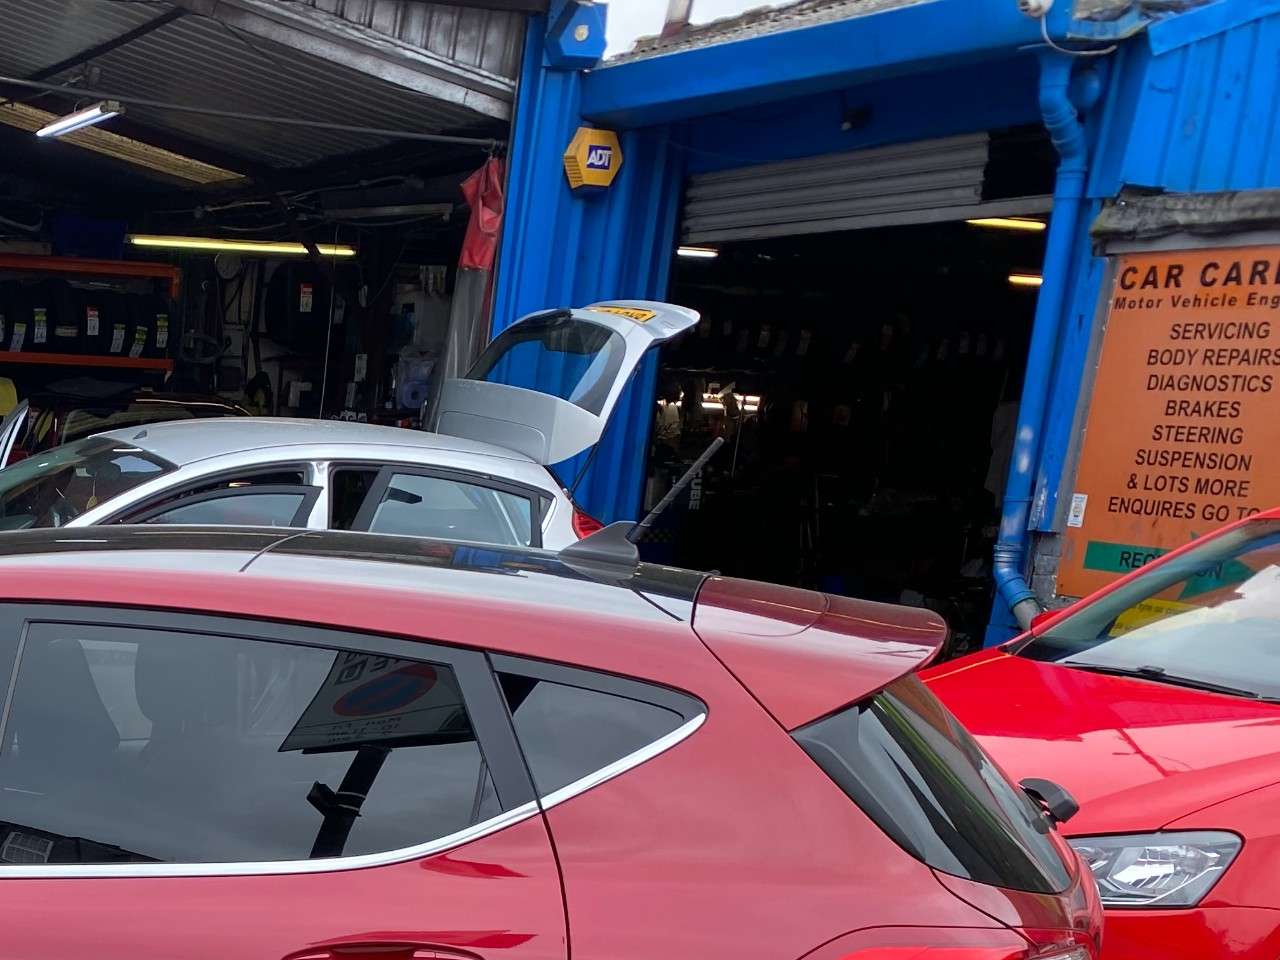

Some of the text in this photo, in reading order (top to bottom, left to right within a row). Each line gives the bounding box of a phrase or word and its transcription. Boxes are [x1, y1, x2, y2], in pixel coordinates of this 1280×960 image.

[586, 149, 613, 167] ADT
[1120, 264, 1184, 290] CAR
[1114, 297, 1162, 310] Motor
[1171, 293, 1238, 308] Vehicle
[1170, 321, 1271, 340] SERVICING
[1147, 348, 1280, 366] BODY REPAIRS
[1147, 374, 1273, 392] DIAGNOSTICS
[1165, 400, 1241, 418] BRAKES
[1152, 425, 1244, 444] STEERING
[1135, 449, 1252, 471] SUSPENSION
[1127, 473, 1250, 497] & LOTS MORE
[1108, 496, 1196, 519] ENQUIRES
[1202, 504, 1229, 521] GO
